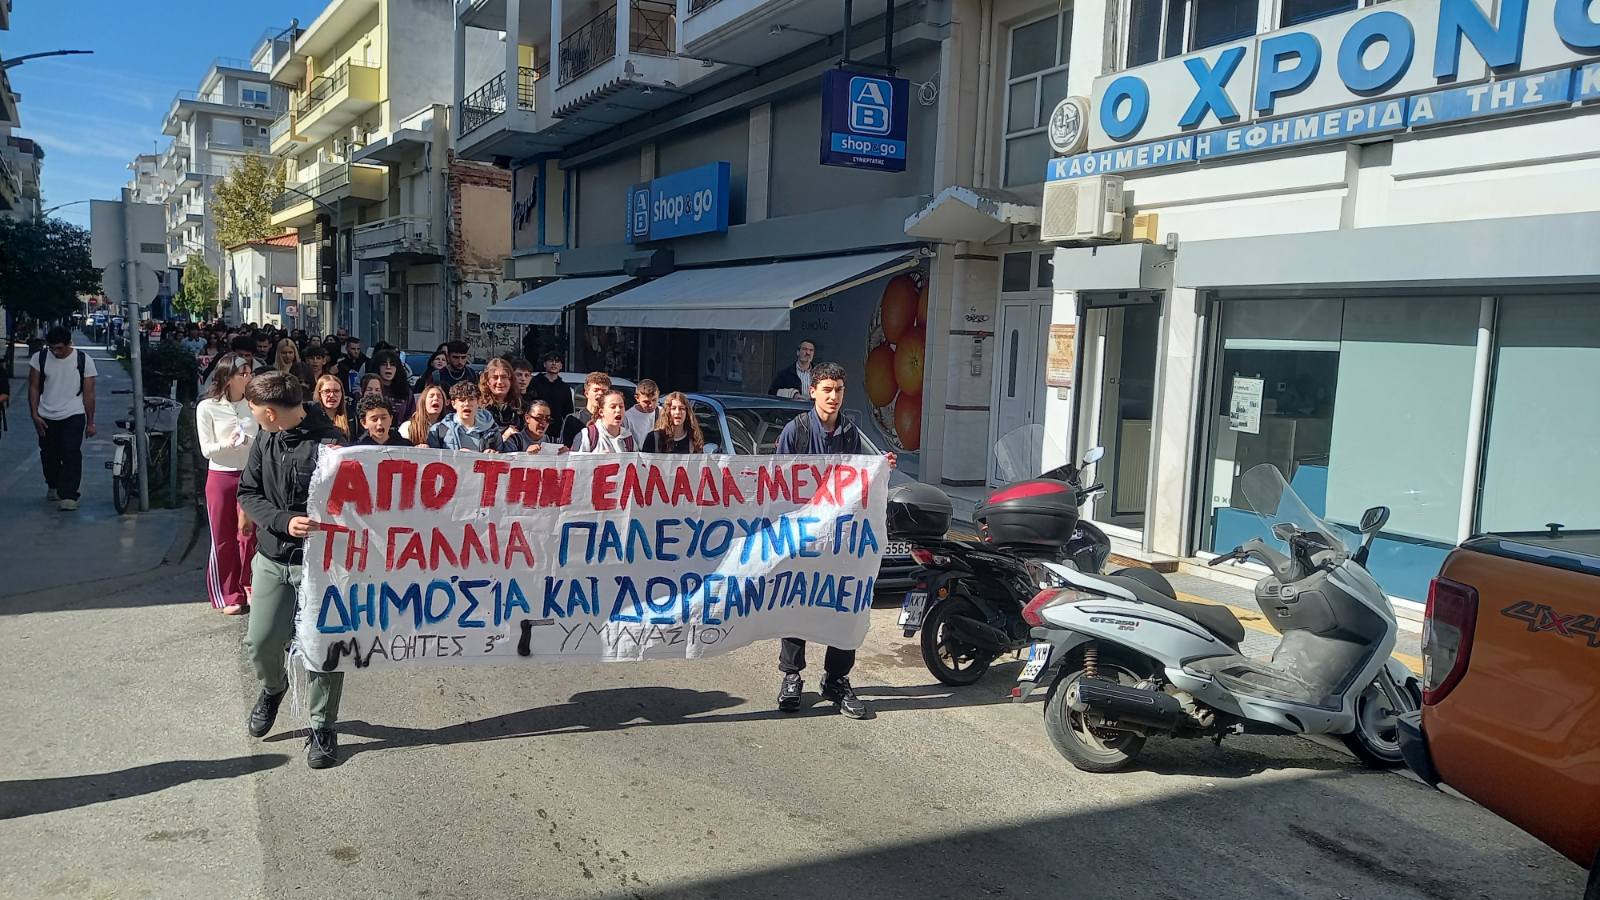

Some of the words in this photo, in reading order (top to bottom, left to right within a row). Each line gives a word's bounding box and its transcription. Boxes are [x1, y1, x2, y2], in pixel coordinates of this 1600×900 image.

[1055, 134, 1210, 178] ΚΑΘΗΜΕΡΙΝΗ
[1226, 96, 1434, 152] ΕΦΗΜΕΡΙΔΑ
[1466, 76, 1545, 112] ΤΗΣ
[1100, 76, 1150, 142] Ο
[327, 459, 458, 515] ΑΠΟ
[473, 459, 575, 508] ΤΗΝ
[591, 463, 745, 511] ΕΛΛΑΔΑ
[756, 463, 869, 509] ΜΕΧΡΙ
[319, 523, 369, 573] ΤΗ
[385, 521, 535, 572] ΓΑΛΛΙΑ
[558, 513, 822, 569] ΠΑΛΕΥΟΥΜΕ
[833, 514, 878, 558] ΓΙΑ
[543, 576, 599, 618] ΚΑΙ
[609, 572, 765, 625] ΔΩΡΕΑΝ
[767, 571, 873, 614] ΠΑΙΔΕΙΑ
[322, 635, 467, 671] ΜΑΘΗΤΕΣ
